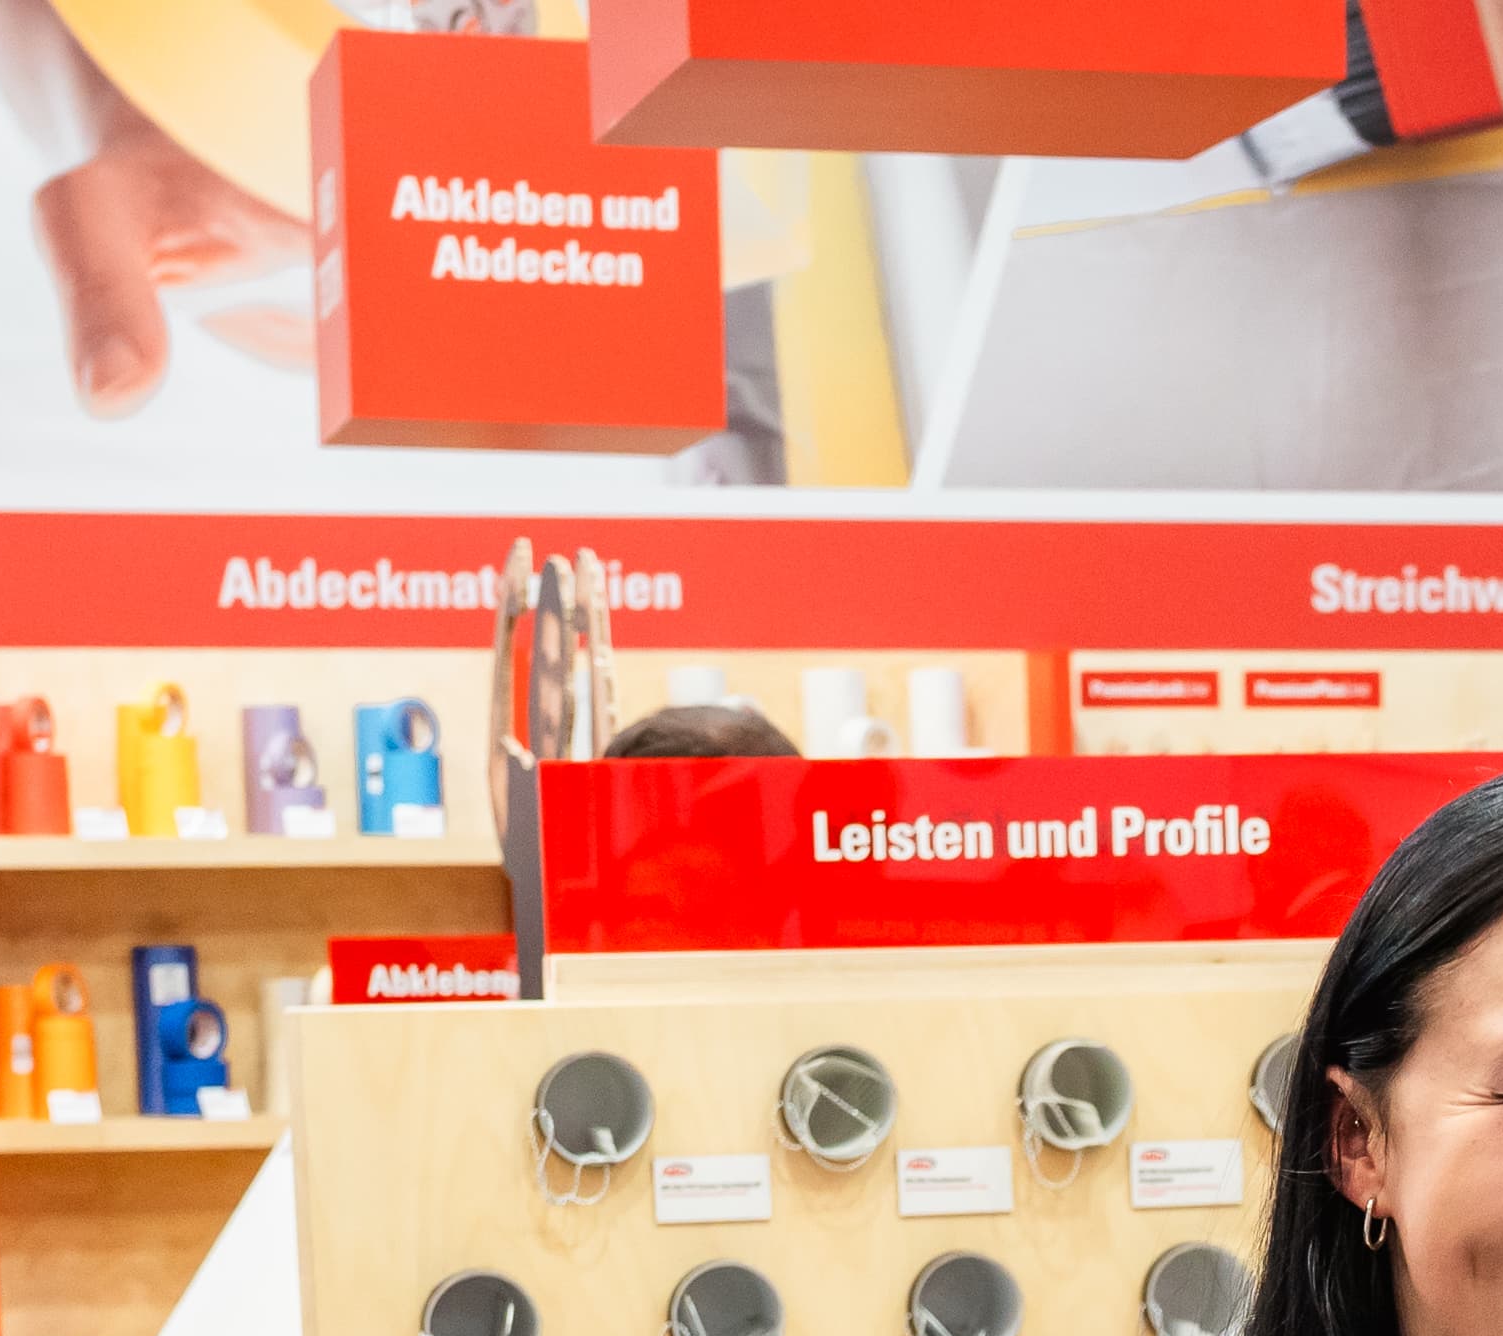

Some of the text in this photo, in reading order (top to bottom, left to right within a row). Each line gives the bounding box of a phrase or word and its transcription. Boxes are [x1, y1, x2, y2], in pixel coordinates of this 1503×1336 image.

[390, 174, 592, 230] Abkleben
[601, 183, 679, 233] und
[431, 235, 644, 288] Abdecken
[813, 804, 1271, 864] Leisten und Profile
